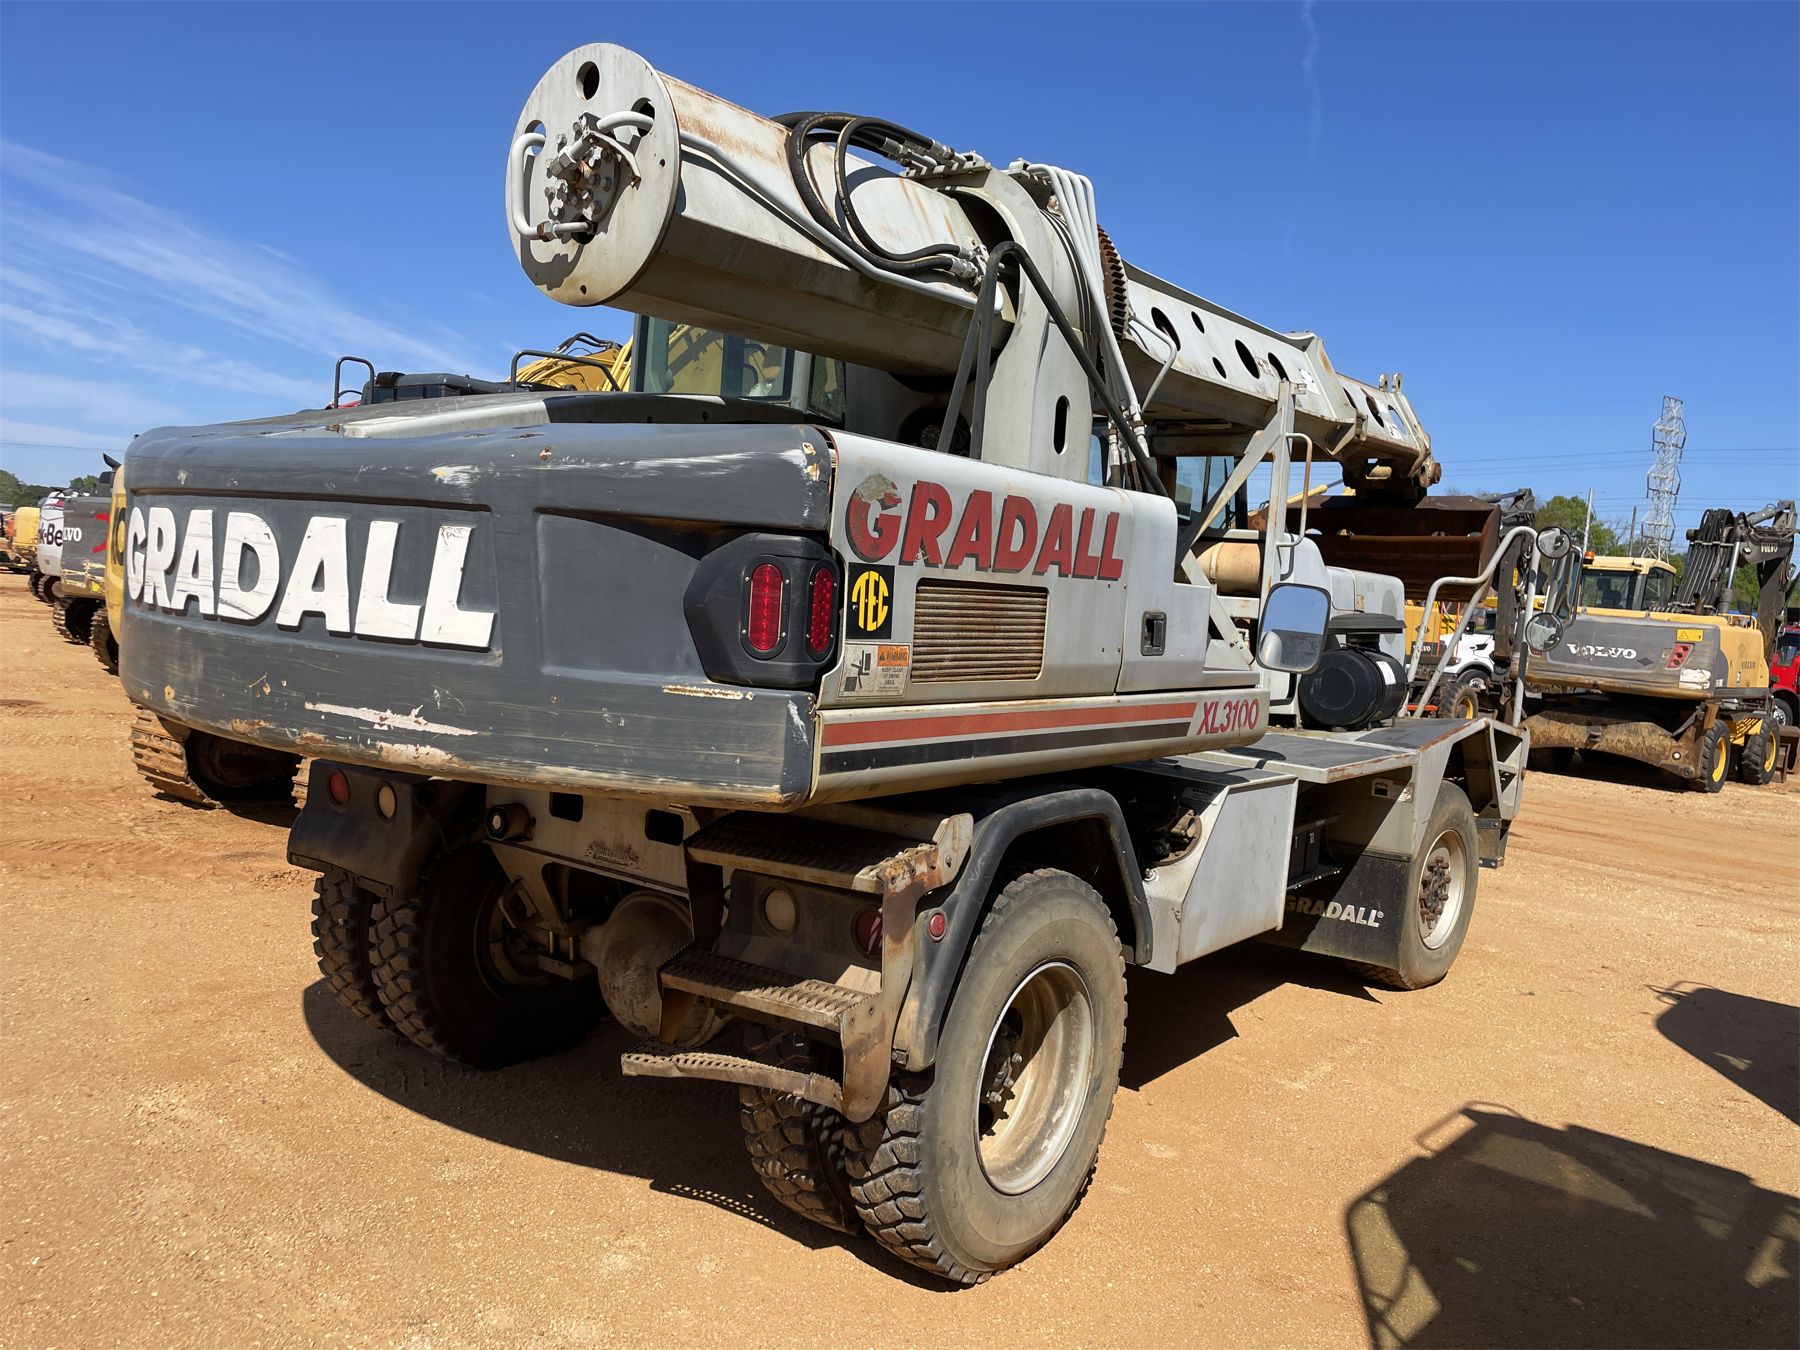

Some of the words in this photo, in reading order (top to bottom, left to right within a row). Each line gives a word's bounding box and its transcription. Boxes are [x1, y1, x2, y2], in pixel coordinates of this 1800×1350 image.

[846, 474, 1125, 580] GRADALL
[126, 507, 495, 649] GRADALL
[852, 571, 889, 631] TEC
[1566, 643, 1637, 659] VOLVO
[1197, 698, 1259, 735] XL3100
